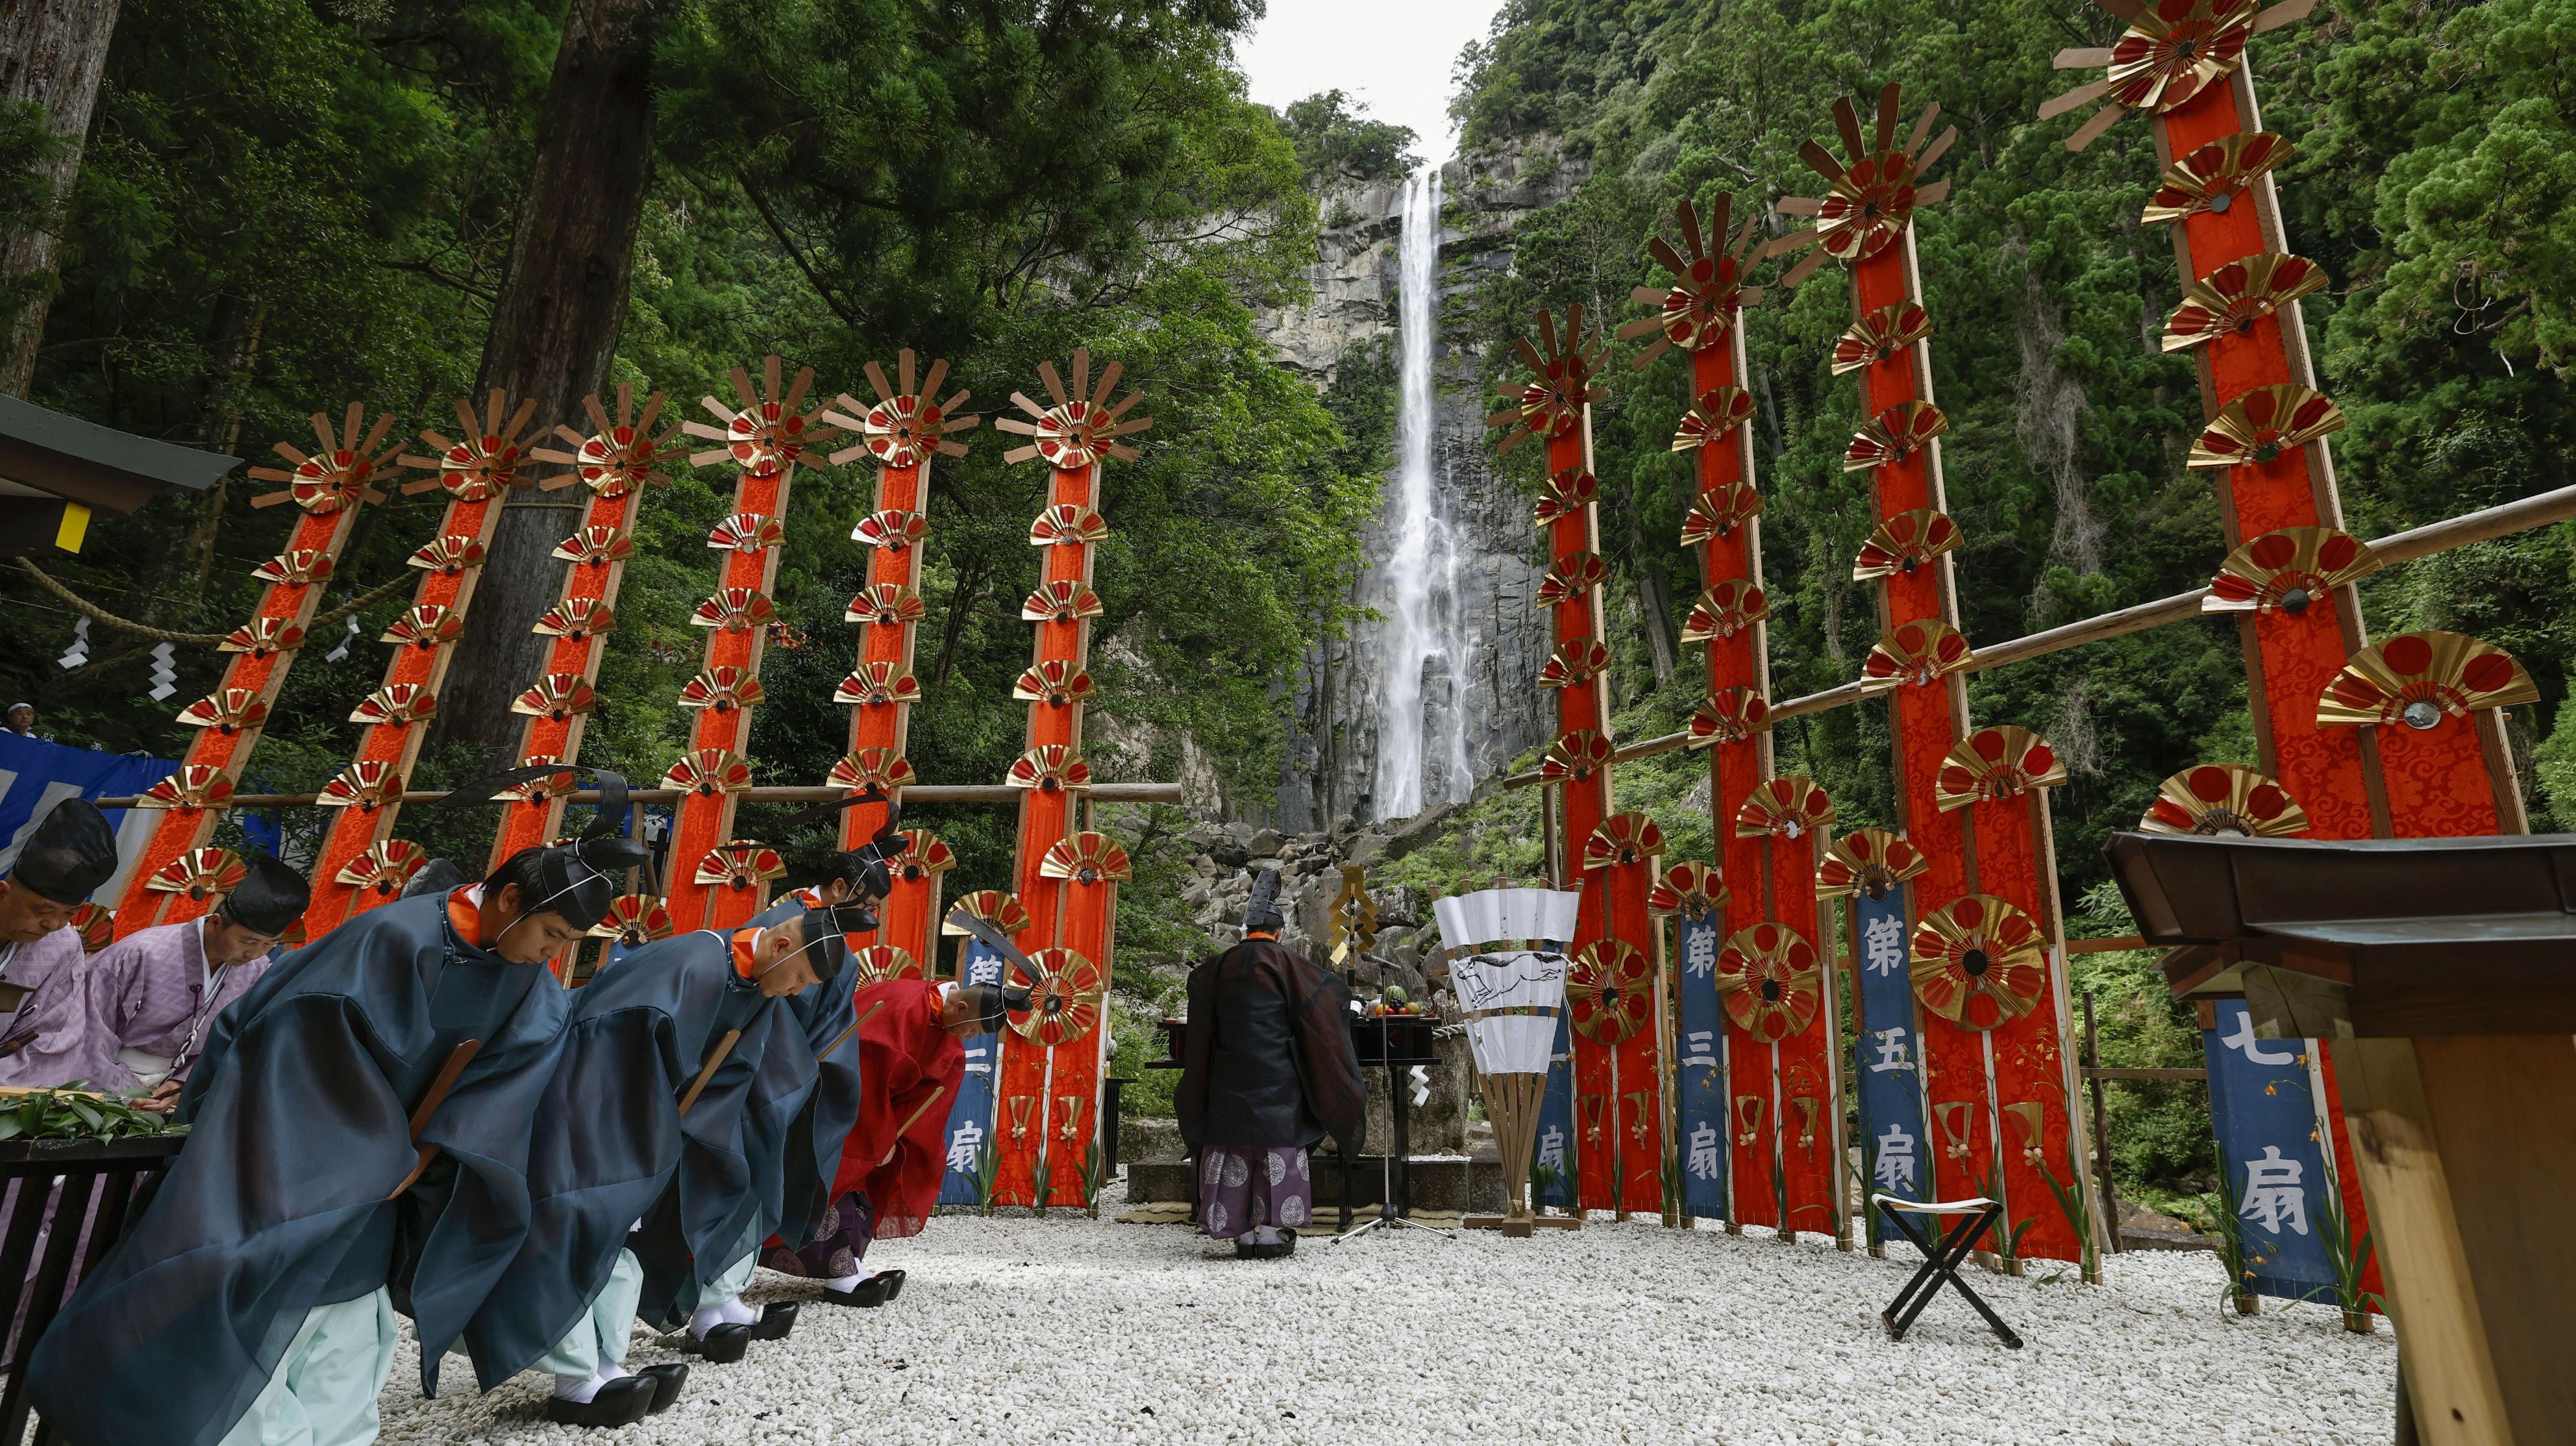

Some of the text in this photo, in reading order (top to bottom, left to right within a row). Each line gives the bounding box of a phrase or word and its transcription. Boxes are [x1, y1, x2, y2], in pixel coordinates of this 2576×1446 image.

[1682, 925, 1718, 1180] 第三扇
[1866, 914, 1915, 1192] 第五扇
